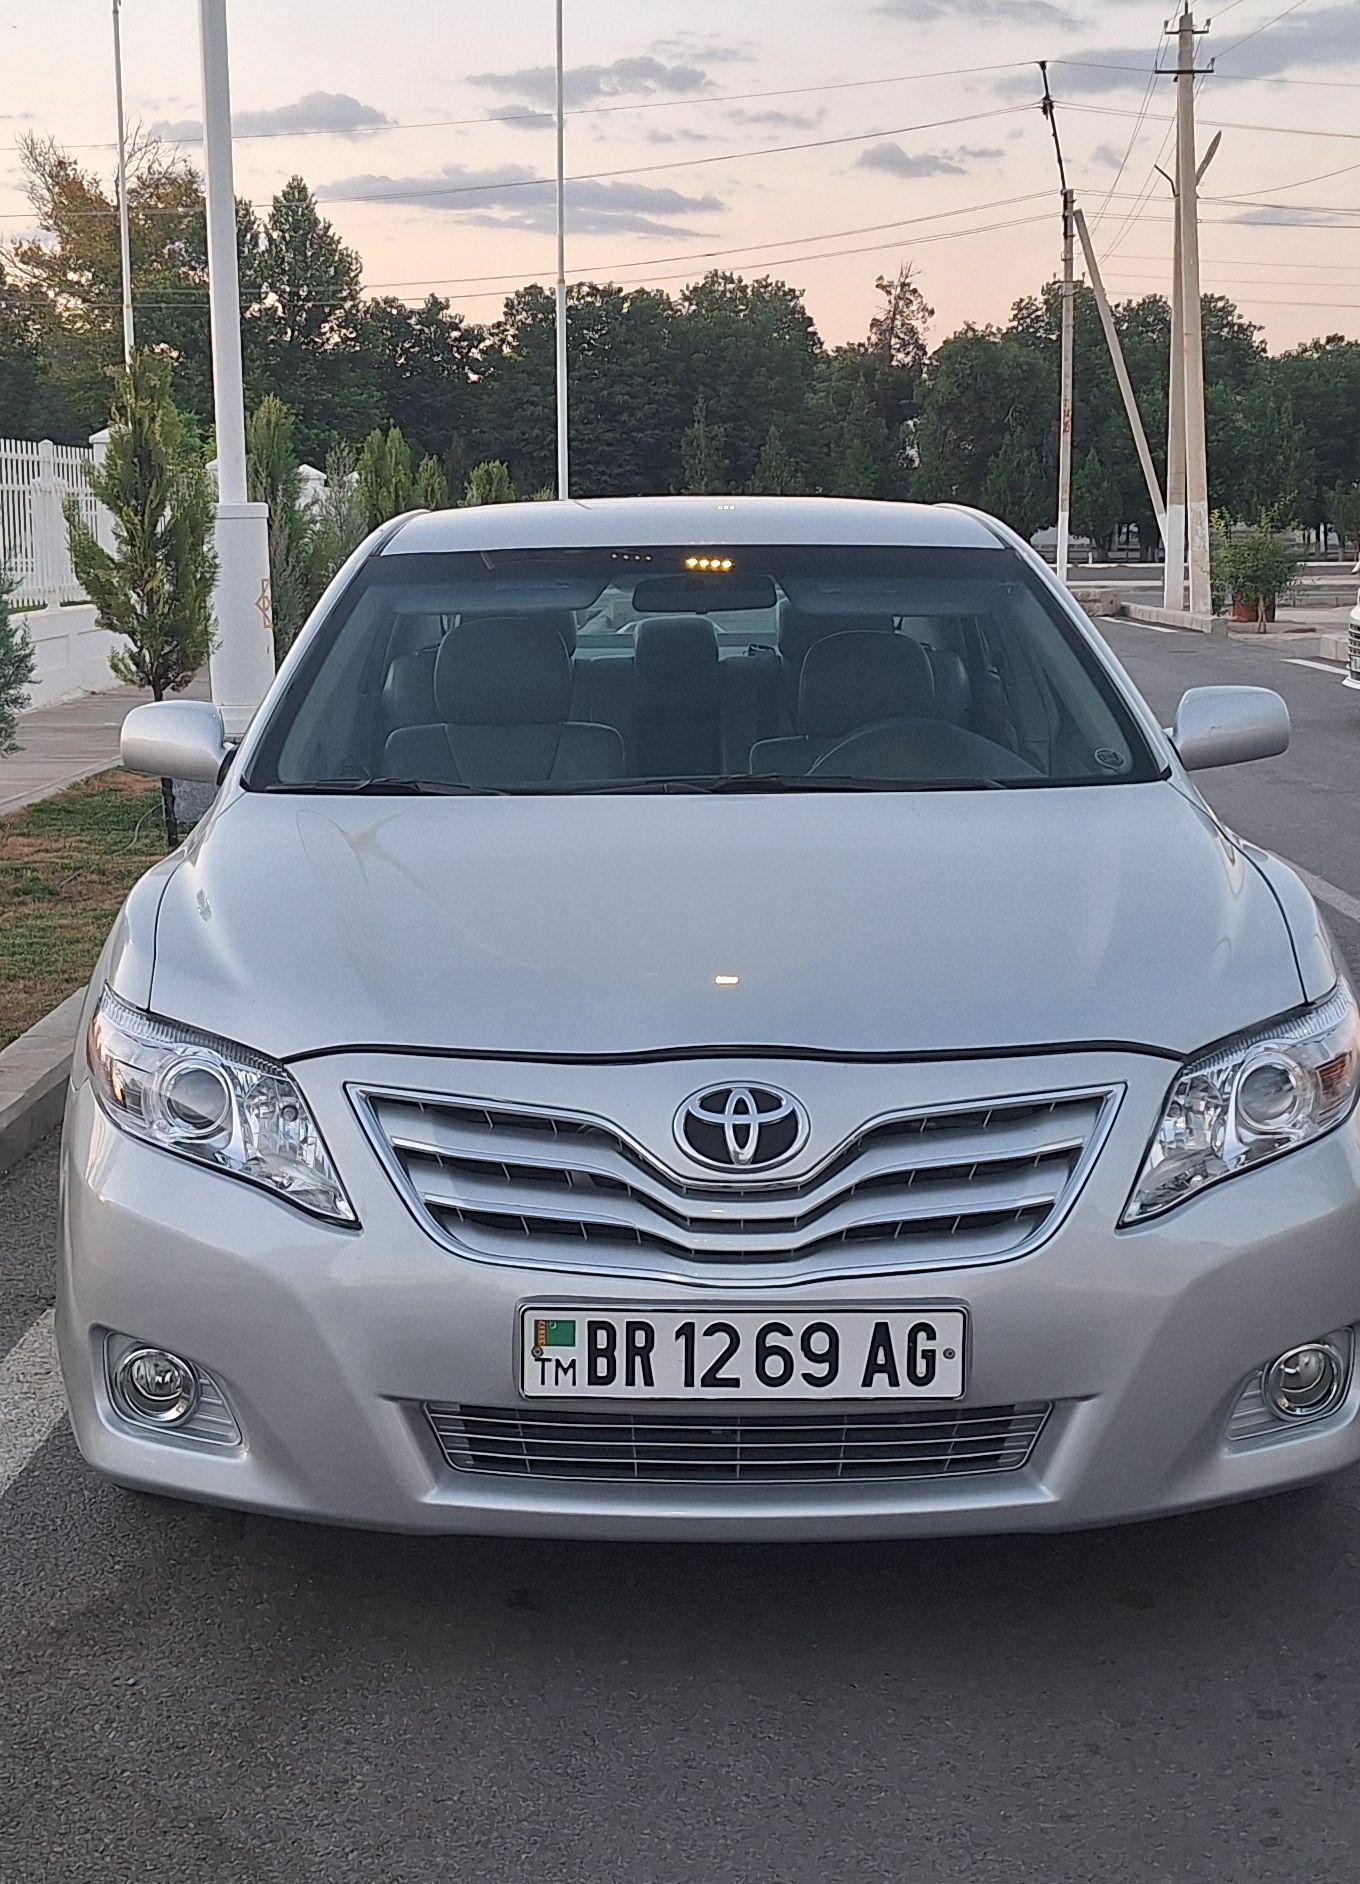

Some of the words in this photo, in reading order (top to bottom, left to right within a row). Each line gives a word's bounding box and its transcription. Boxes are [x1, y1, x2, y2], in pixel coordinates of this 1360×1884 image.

[534, 1358, 577, 1386] TM
[587, 1320, 654, 1387] BR
[861, 1321, 936, 1388] AG
